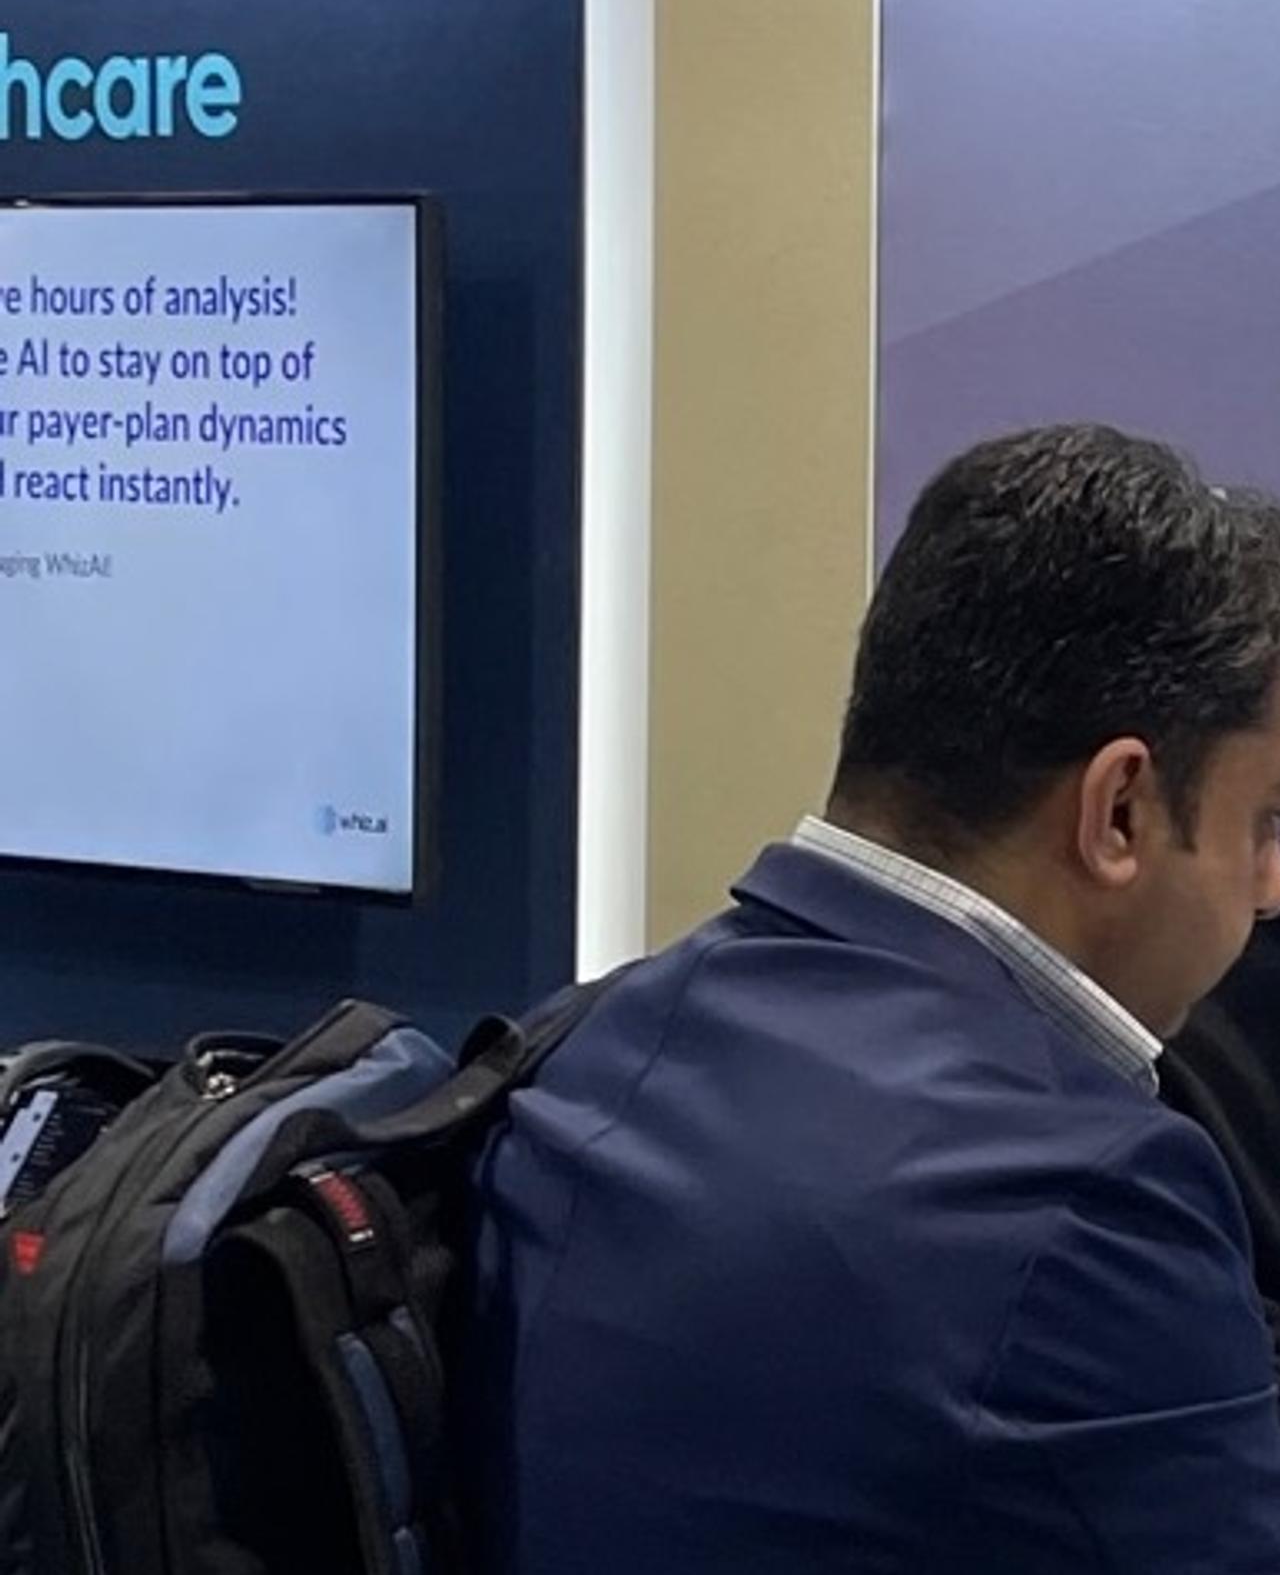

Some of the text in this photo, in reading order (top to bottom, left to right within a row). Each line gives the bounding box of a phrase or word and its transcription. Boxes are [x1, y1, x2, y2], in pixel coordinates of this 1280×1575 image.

[0, 275, 297, 324] e hours of analysis!
[17, 338, 49, 376] AI
[60, 342, 90, 378] to
[100, 343, 162, 386] stay
[171, 351, 210, 378] on
[220, 344, 271, 388] top
[282, 341, 316, 380] of
[28, 401, 191, 448] payer-plan
[199, 402, 348, 452] dynamics
[14, 467, 90, 501] react
[99, 462, 241, 514] instantly.
